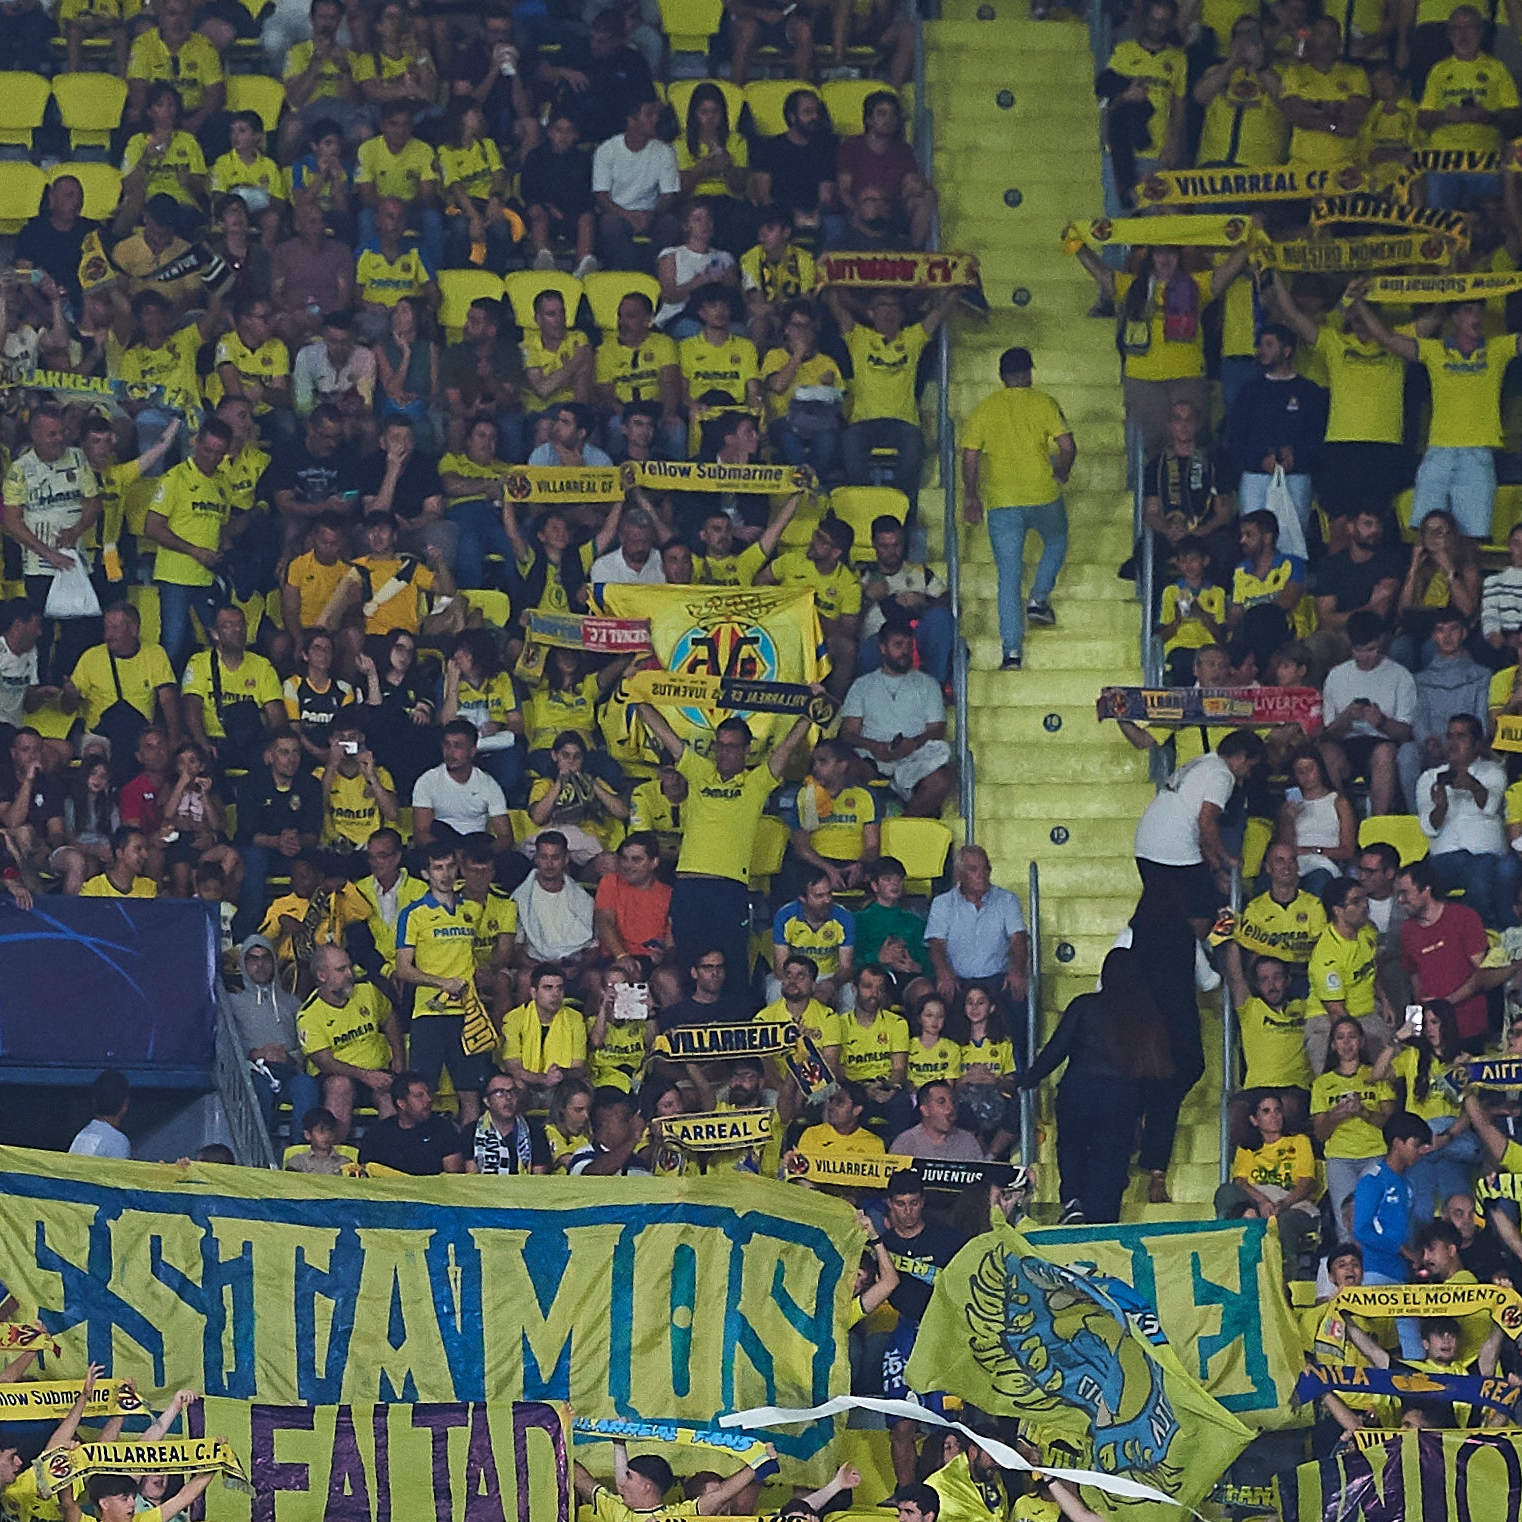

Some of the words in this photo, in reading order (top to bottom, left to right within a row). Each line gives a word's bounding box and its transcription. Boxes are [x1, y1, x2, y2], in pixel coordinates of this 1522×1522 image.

[1176, 172, 1297, 195] VILLARREAL
[1304, 170, 1328, 193] CF
[640, 461, 691, 480] Yellow
[695, 462, 782, 481] Submarine
[667, 1026, 781, 1057] VILLARREAL
[814, 1158, 881, 1177] VILLARREAL
[922, 1167, 982, 1184] JUVENTUS
[82, 1444, 187, 1465] VILLARREAL
